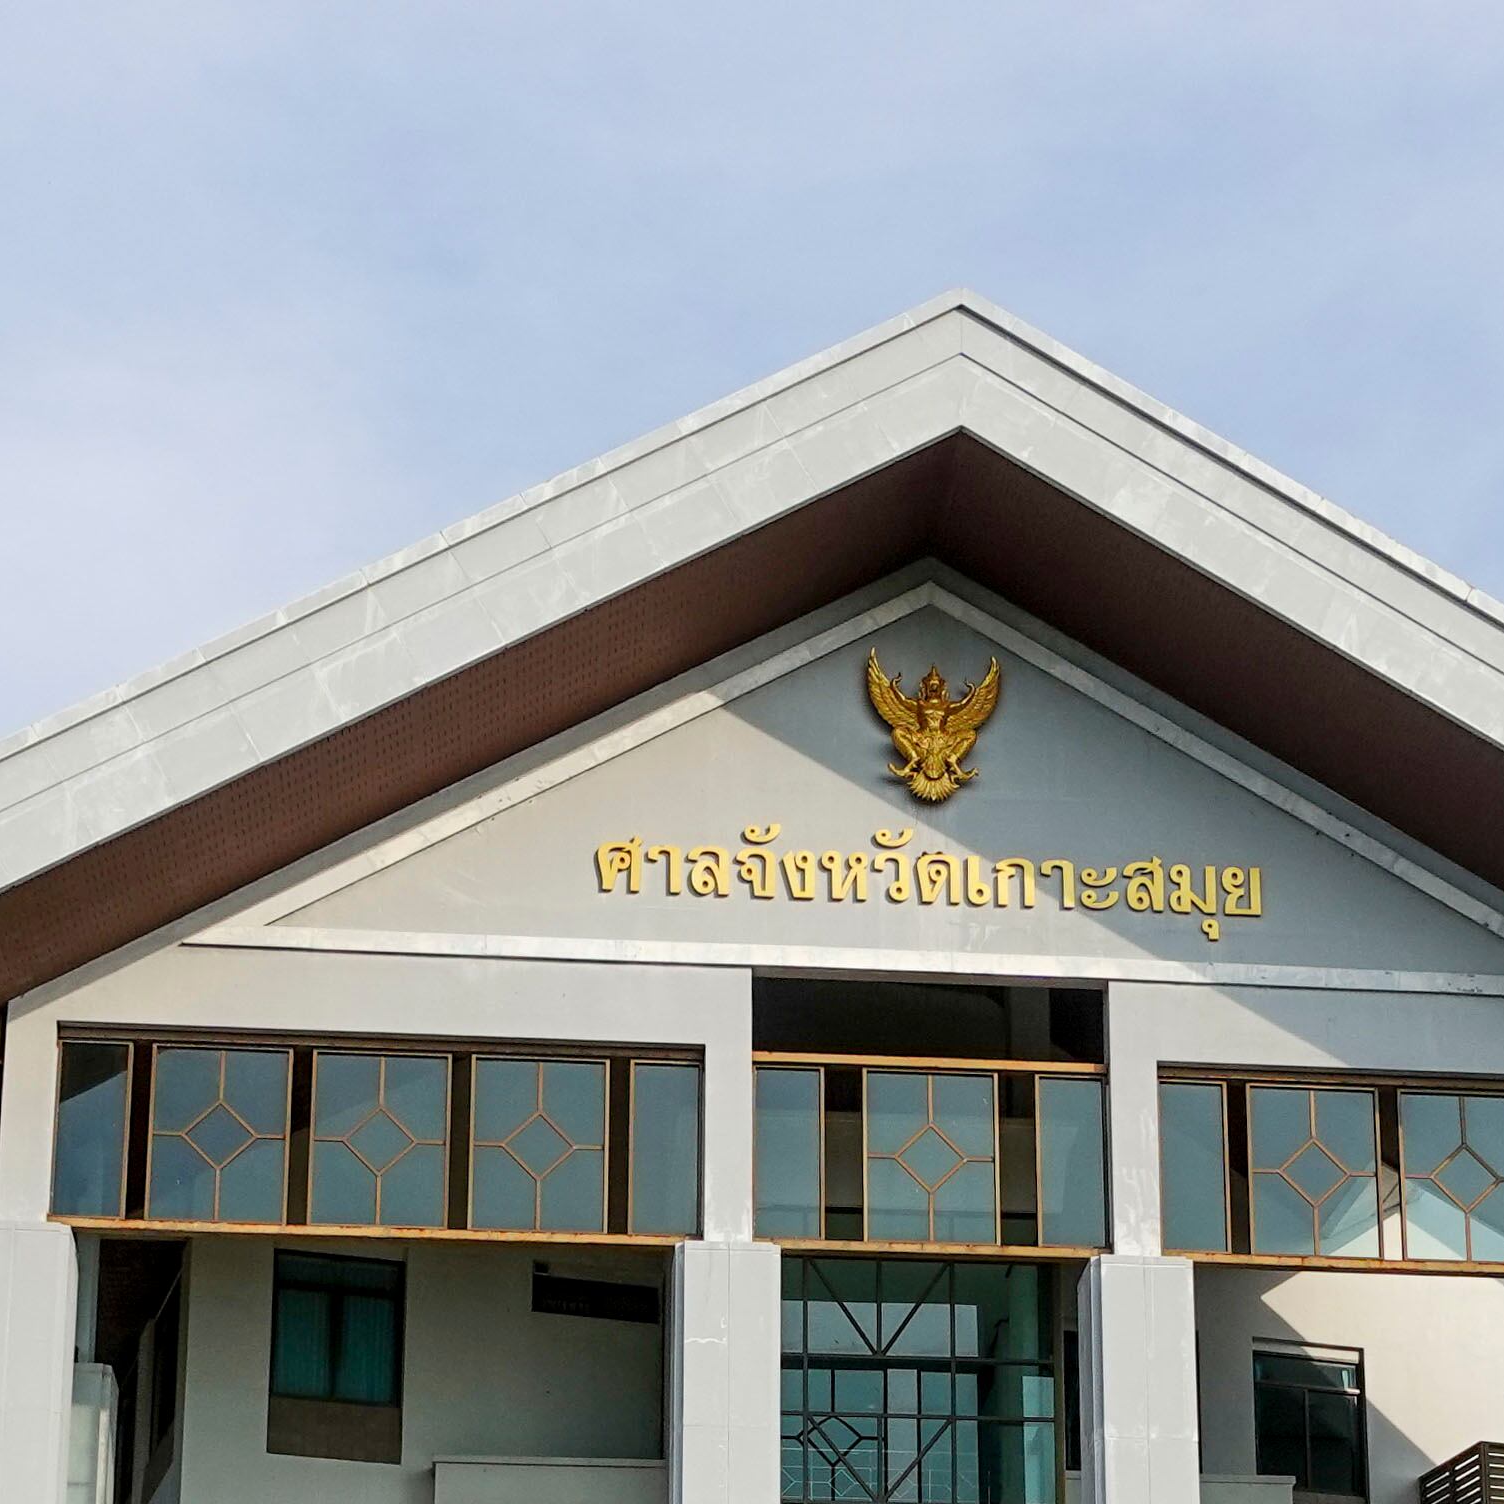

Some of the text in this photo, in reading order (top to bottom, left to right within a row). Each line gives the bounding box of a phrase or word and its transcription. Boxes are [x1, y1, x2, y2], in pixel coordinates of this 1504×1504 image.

[596, 823, 1263, 941] ศาลจังหวัดเกาะสมุย
